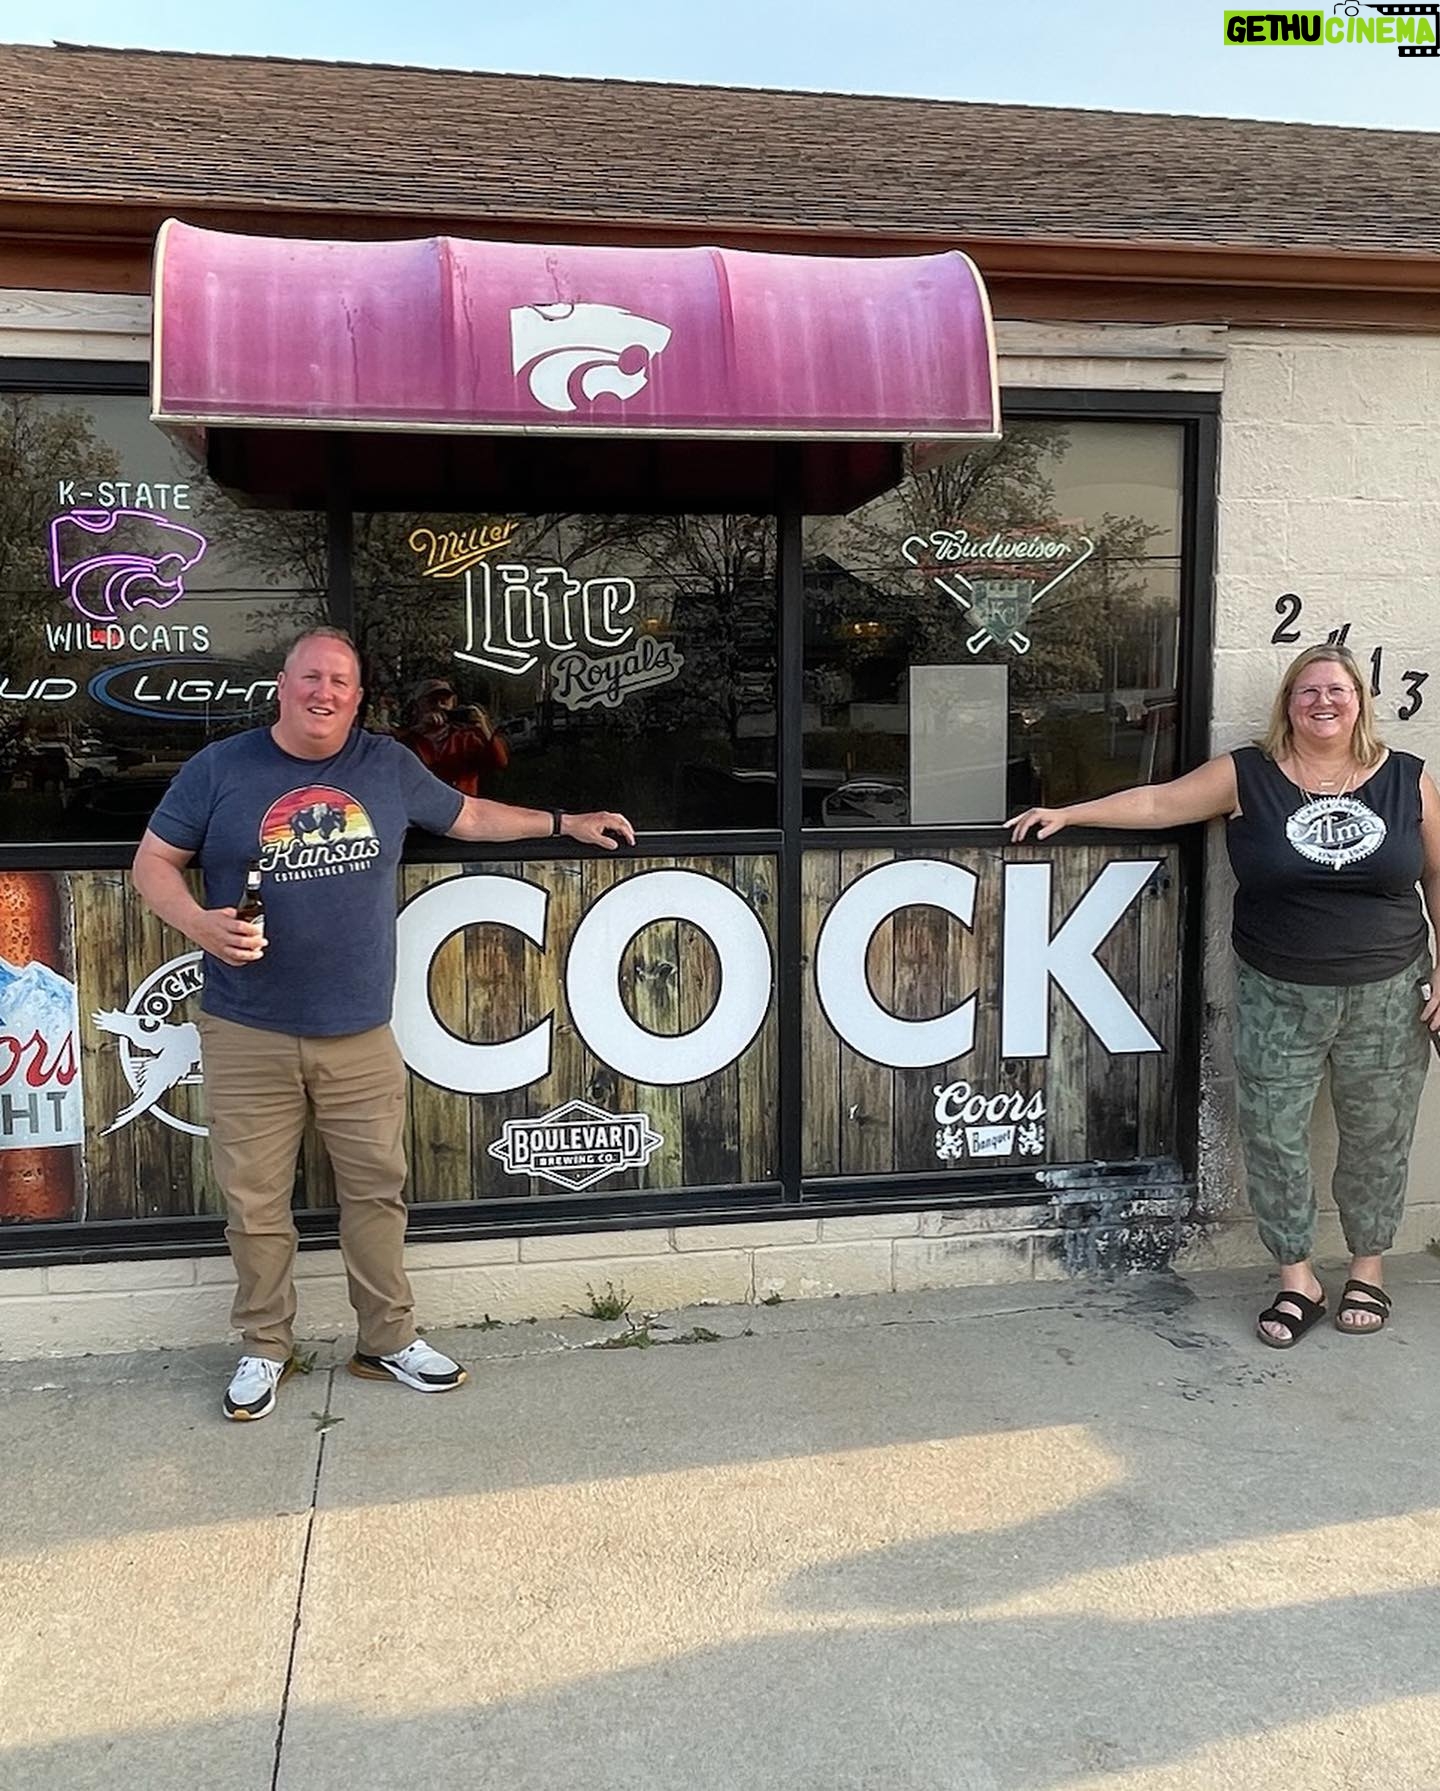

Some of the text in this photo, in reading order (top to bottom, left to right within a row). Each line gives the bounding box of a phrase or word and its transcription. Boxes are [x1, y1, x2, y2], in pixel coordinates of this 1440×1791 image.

[58, 481, 191, 509] K-STATE
[409, 522, 519, 567] Miller
[930, 530, 1071, 561] Budweiser
[454, 561, 636, 675] Lite
[46, 623, 210, 652] WILDCATS
[560, 641, 674, 701] Royals
[0, 677, 78, 700] UD
[1292, 814, 1377, 843] Alma
[260, 839, 380, 871] Kansas
[393, 858, 1165, 1095] COCK
[933, 1081, 1047, 1125] Coors
[514, 1123, 639, 1163] BOULEVARD
[539, 1154, 595, 1166] BREWING
